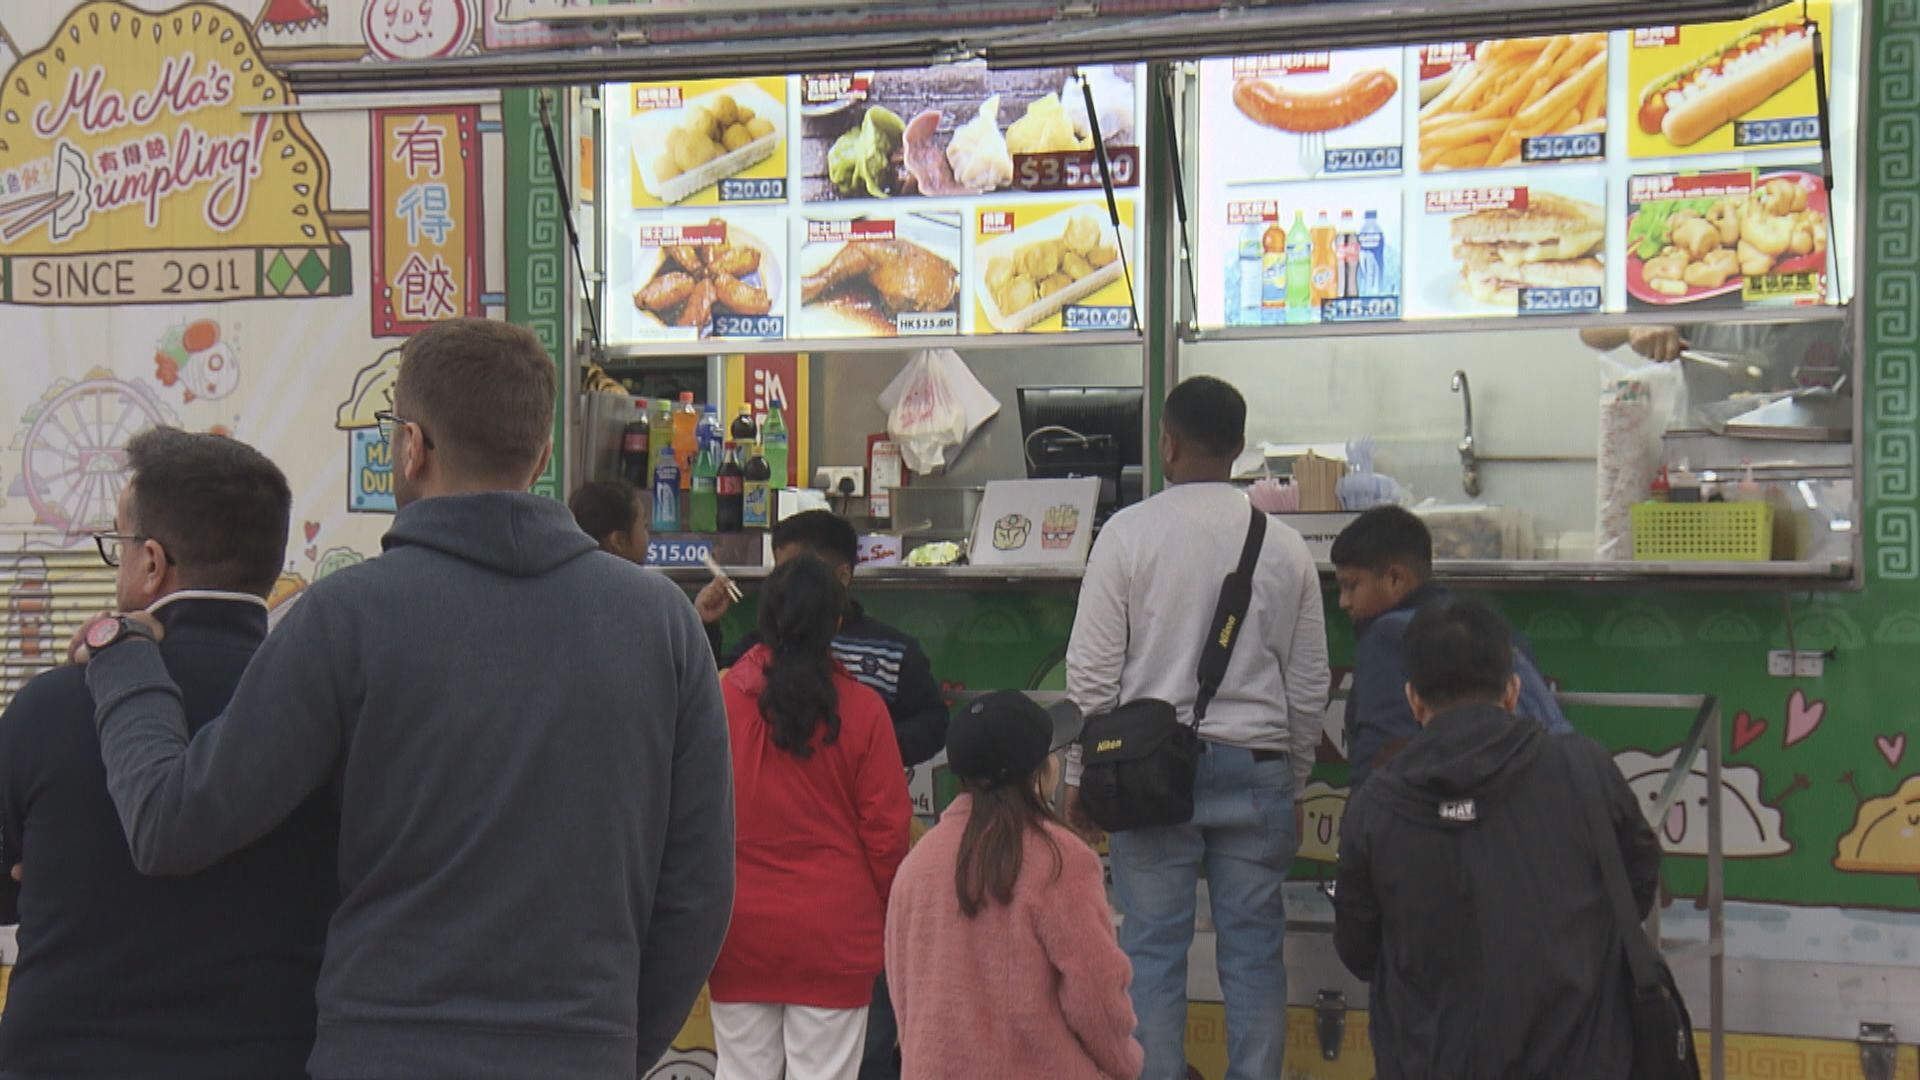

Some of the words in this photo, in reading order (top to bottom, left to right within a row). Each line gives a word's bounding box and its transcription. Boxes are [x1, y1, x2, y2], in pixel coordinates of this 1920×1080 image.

[36, 69, 124, 134] Ma
[133, 57, 233, 119] Ma's
[1736, 119, 1819, 143] $30.00
[1326, 150, 1400, 172] $20.00
[723, 180, 784, 200] $20.00
[395, 119, 457, 317] 有得餃
[32, 262, 136, 297] SINCE
[161, 259, 241, 294] 2011
[1323, 299, 1397, 321] $15.00
[1523, 287, 1598, 312] $20.00
[716, 317, 781, 336] $20.00
[647, 543, 708, 562] $15.00
[1218, 613, 1237, 648] Nikon
[1096, 738, 1123, 752] Nikon
